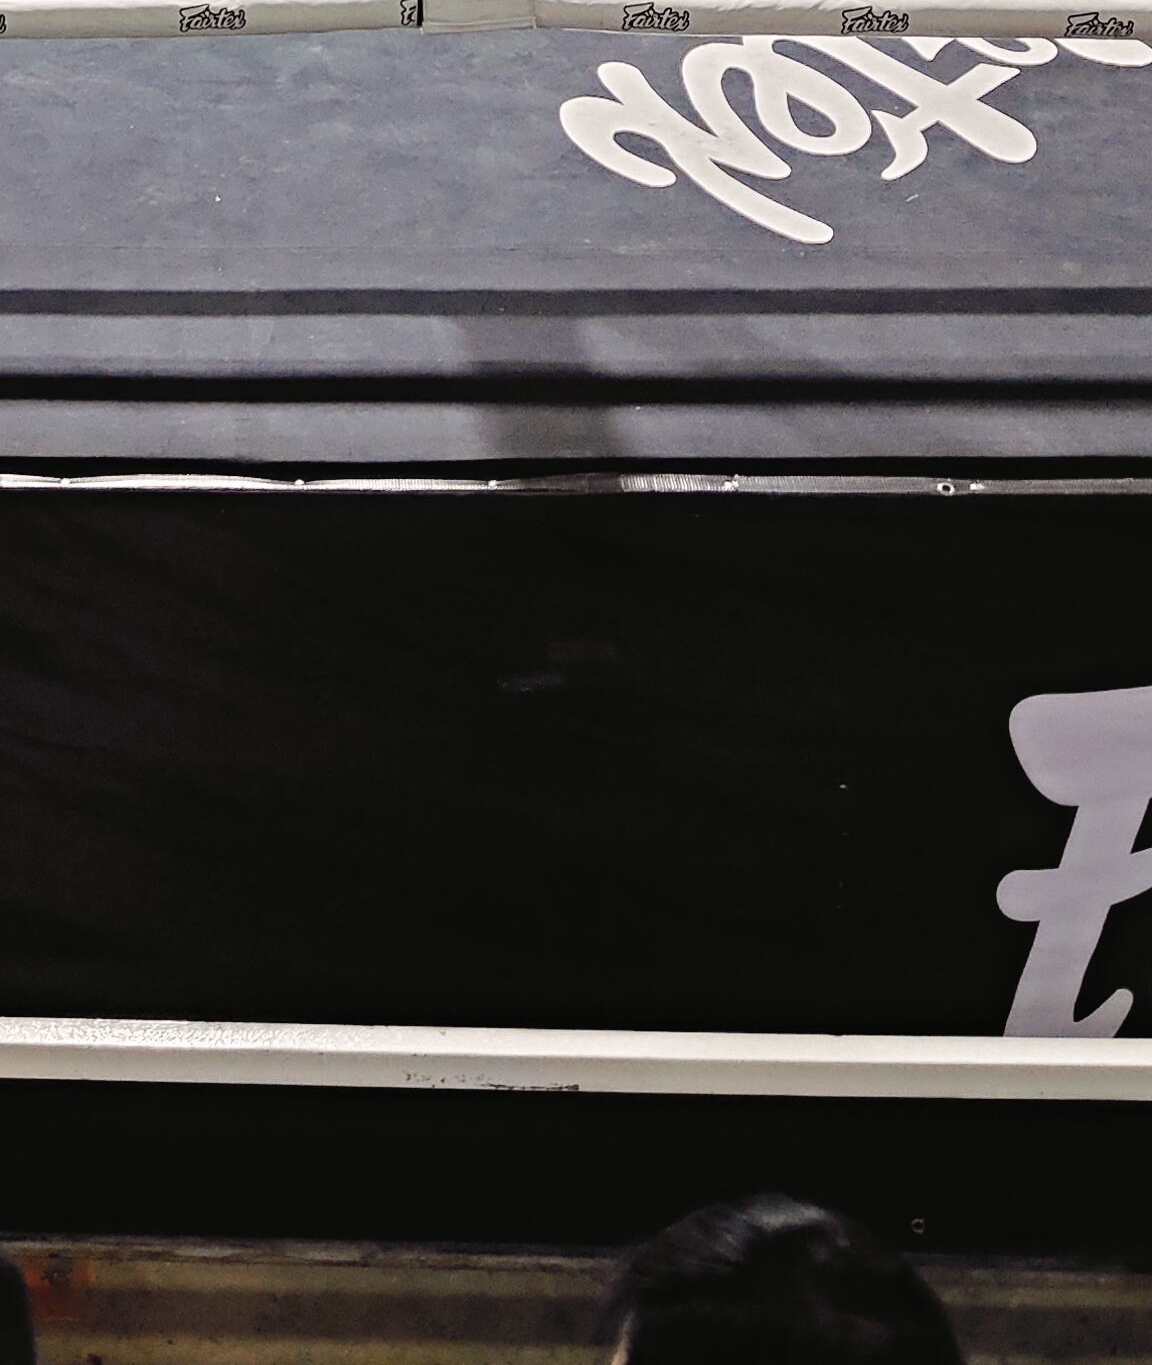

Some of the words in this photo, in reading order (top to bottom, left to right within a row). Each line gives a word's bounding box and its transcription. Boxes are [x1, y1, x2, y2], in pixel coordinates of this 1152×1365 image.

[178, 3, 246, 33] Fairtex
[621, 2, 691, 33] Fairtex
[840, 6, 909, 36] Fairtex
[1064, 11, 1135, 39] Fairtex
